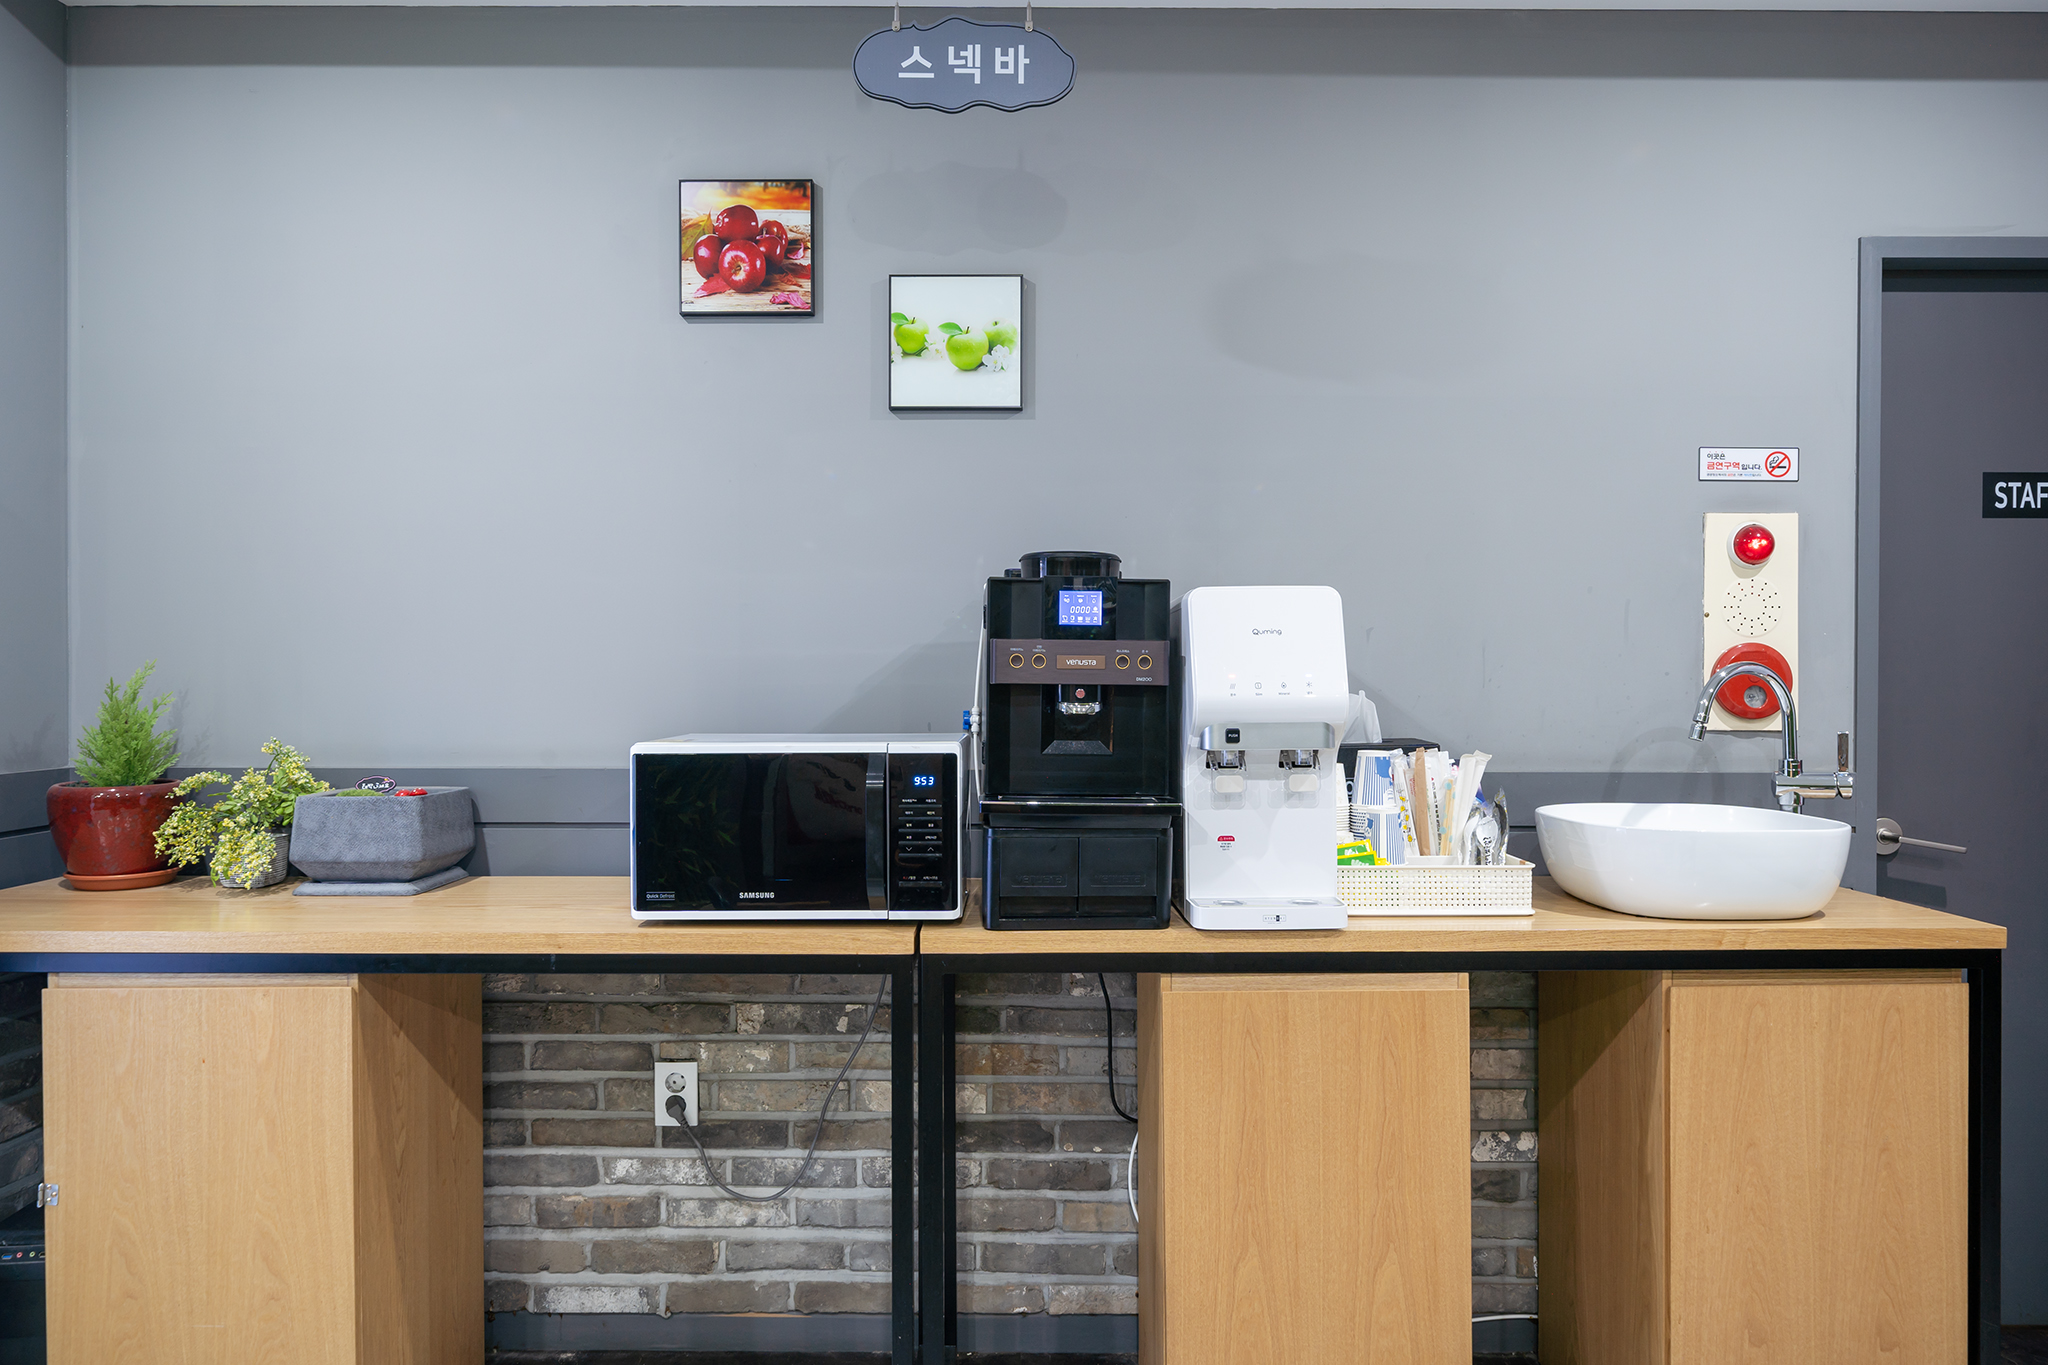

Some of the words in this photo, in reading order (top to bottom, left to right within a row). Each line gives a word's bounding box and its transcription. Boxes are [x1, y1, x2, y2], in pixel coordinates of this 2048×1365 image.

[1706, 452, 1726, 460] 이곳은
[1706, 461, 1740, 470] 금연구역
[1070, 605, 1091, 614] 0000
[1252, 628, 1282, 636] Quming
